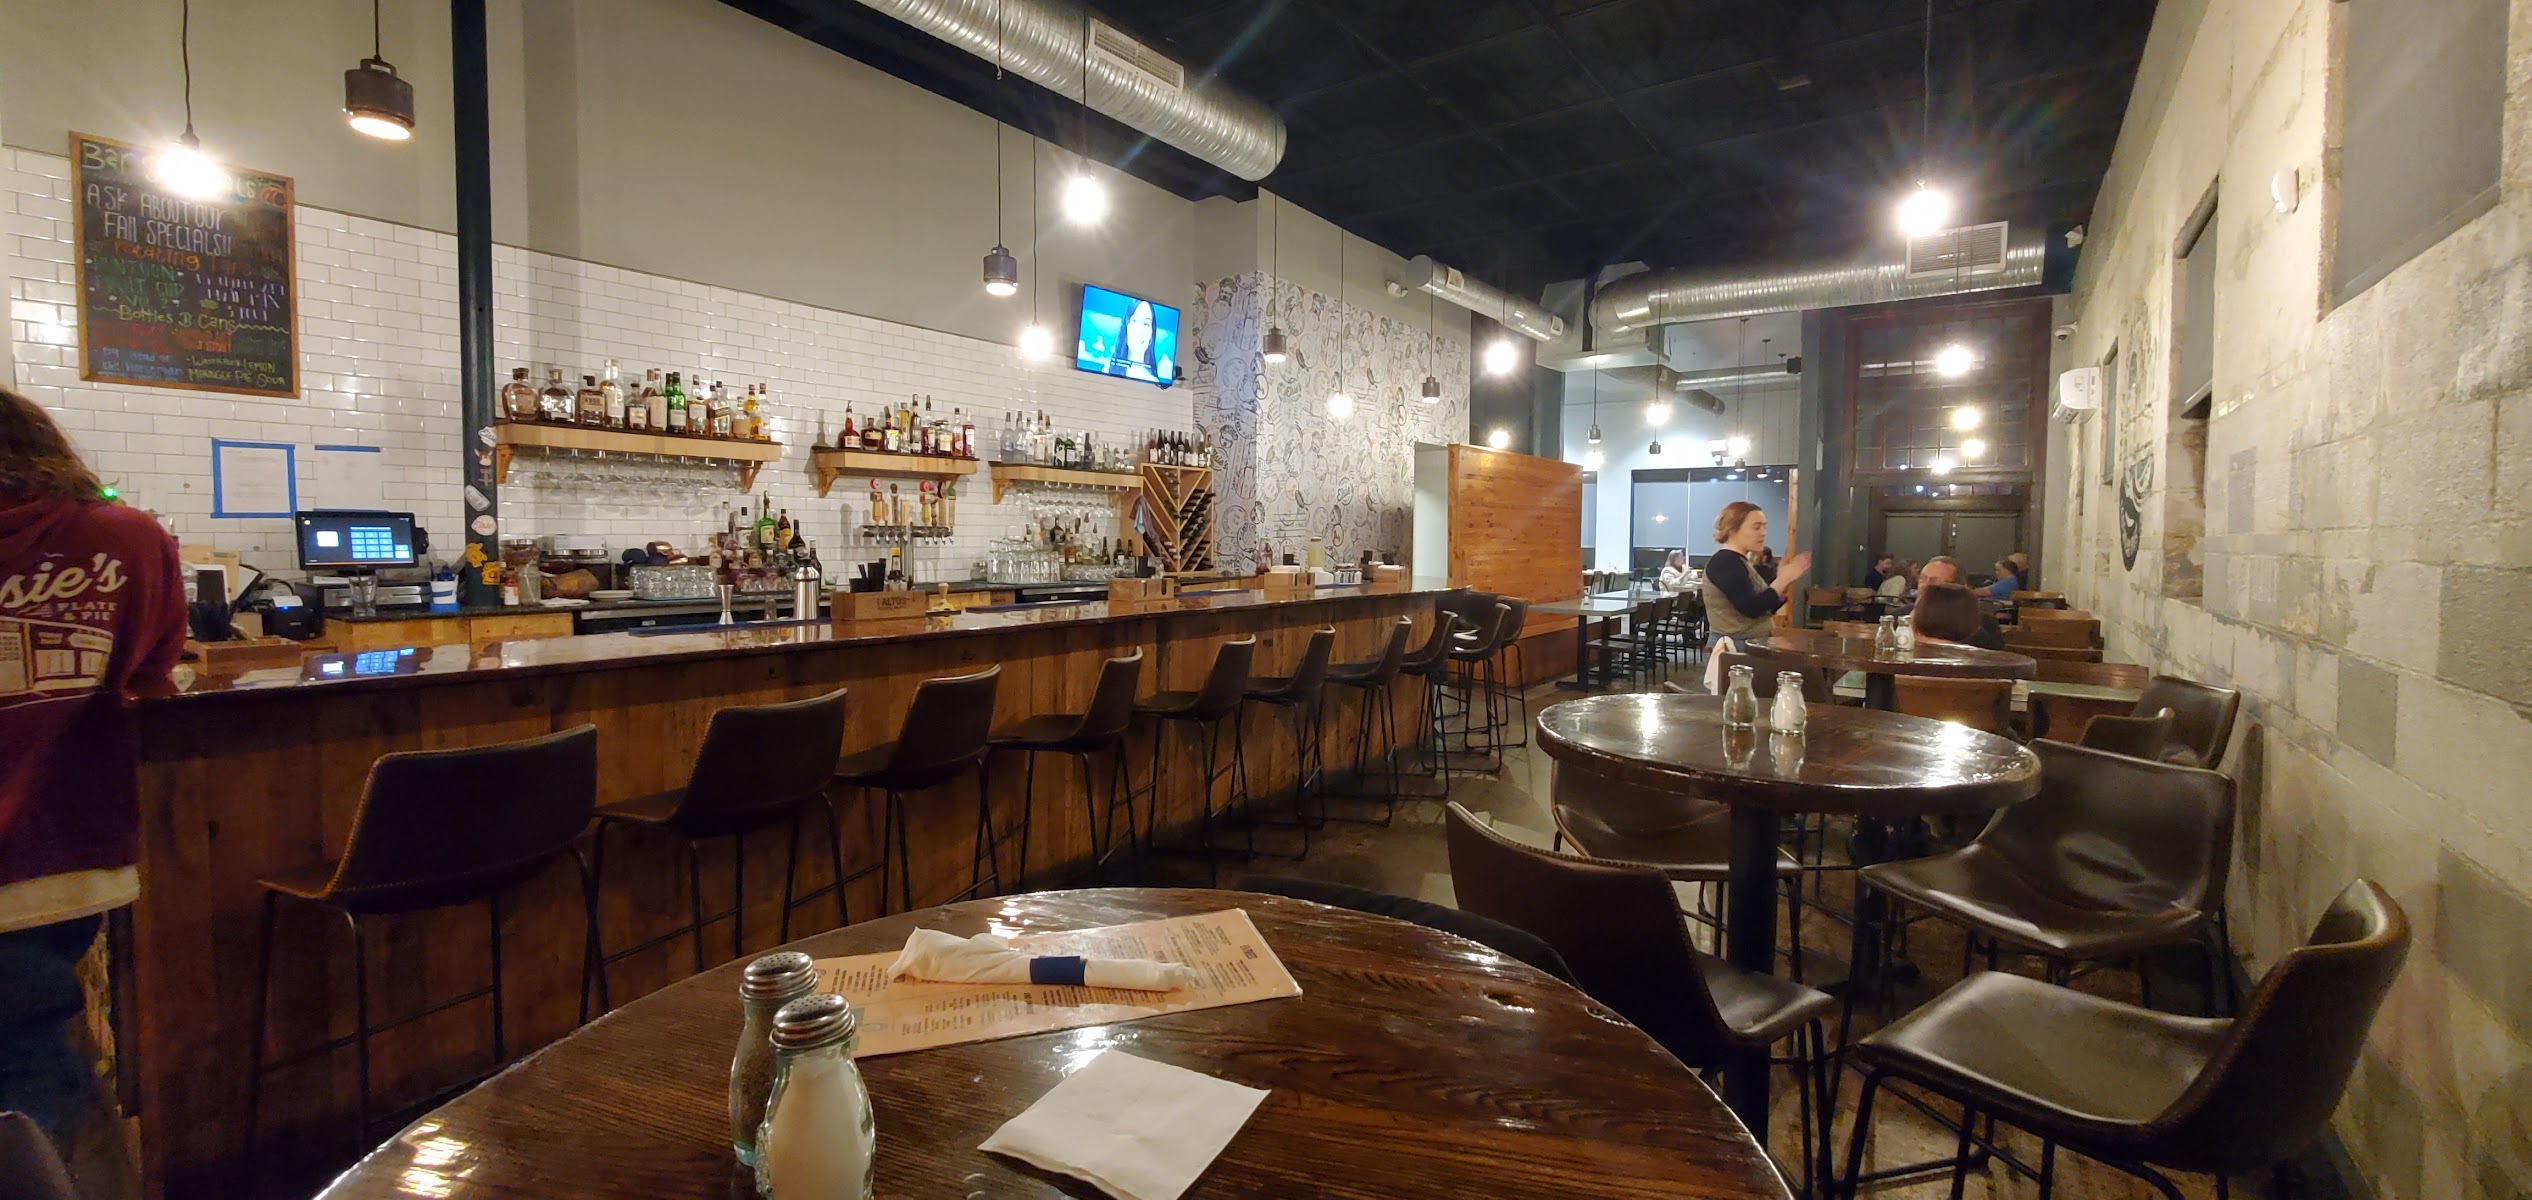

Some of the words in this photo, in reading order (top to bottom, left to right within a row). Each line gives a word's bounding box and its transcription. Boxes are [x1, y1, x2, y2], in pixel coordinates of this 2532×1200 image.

[82, 142, 135, 174] Bar
[86, 183, 128, 211] ASK
[140, 193, 191, 224] ABOUT
[146, 219, 232, 257] SPECIALS!!
[119, 303, 174, 325] Bottles
[199, 312, 237, 333] Cans
[56, 602, 118, 611] PLATE
[81, 611, 111, 621] PIE
